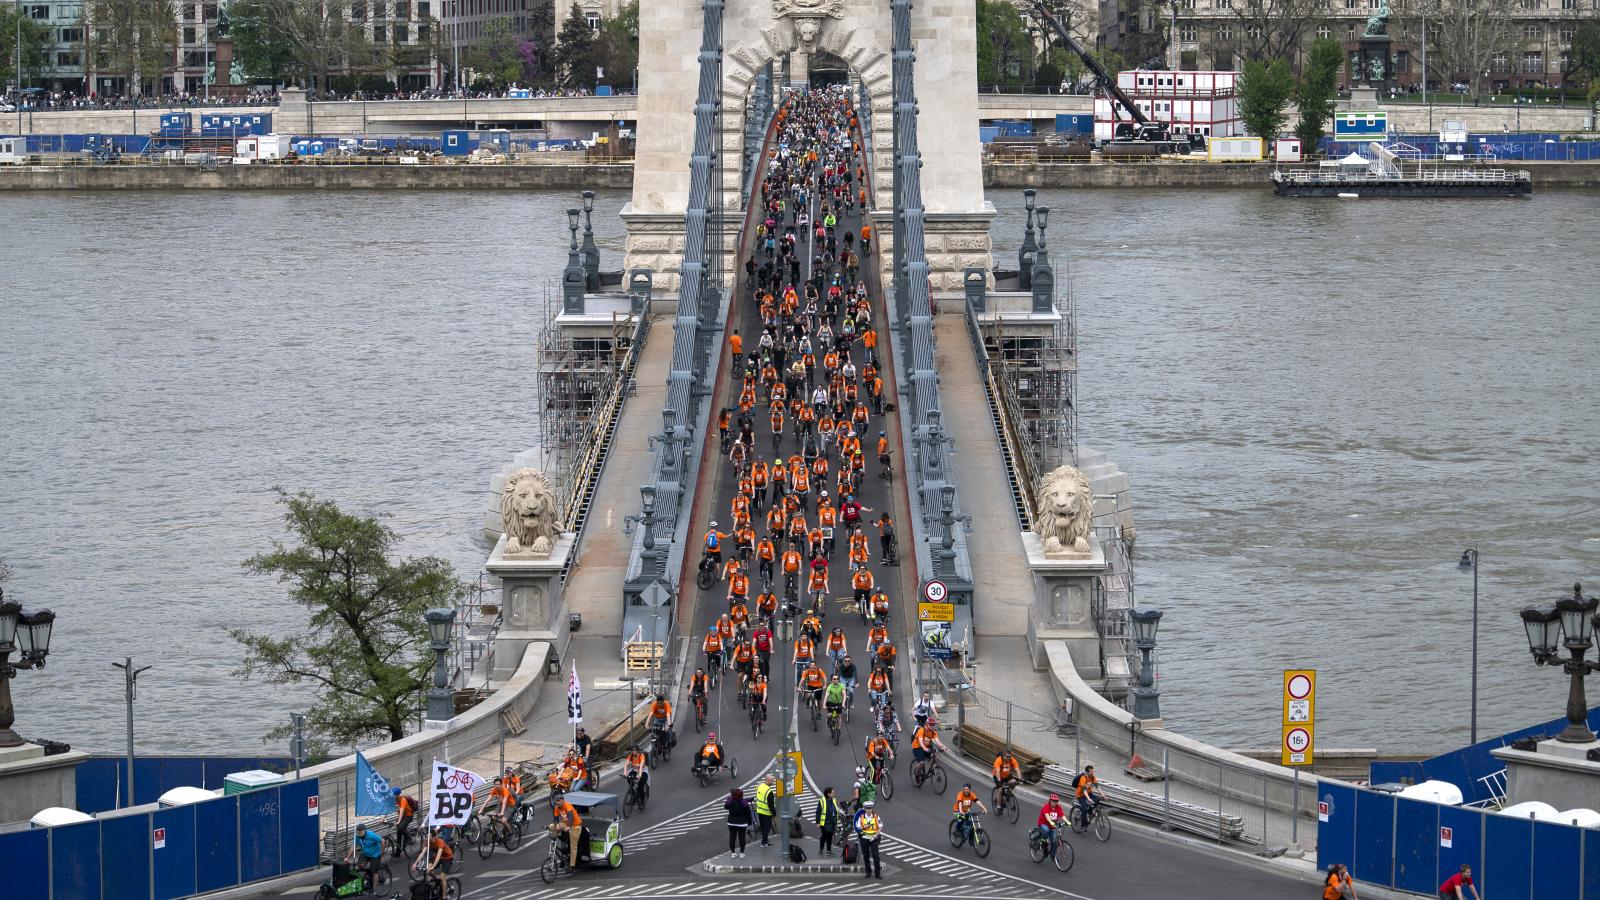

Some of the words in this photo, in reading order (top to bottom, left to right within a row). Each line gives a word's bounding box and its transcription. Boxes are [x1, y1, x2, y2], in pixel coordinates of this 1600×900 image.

[930, 587, 942, 596] 30
[436, 766, 449, 790] I
[434, 792, 472, 819] BP
